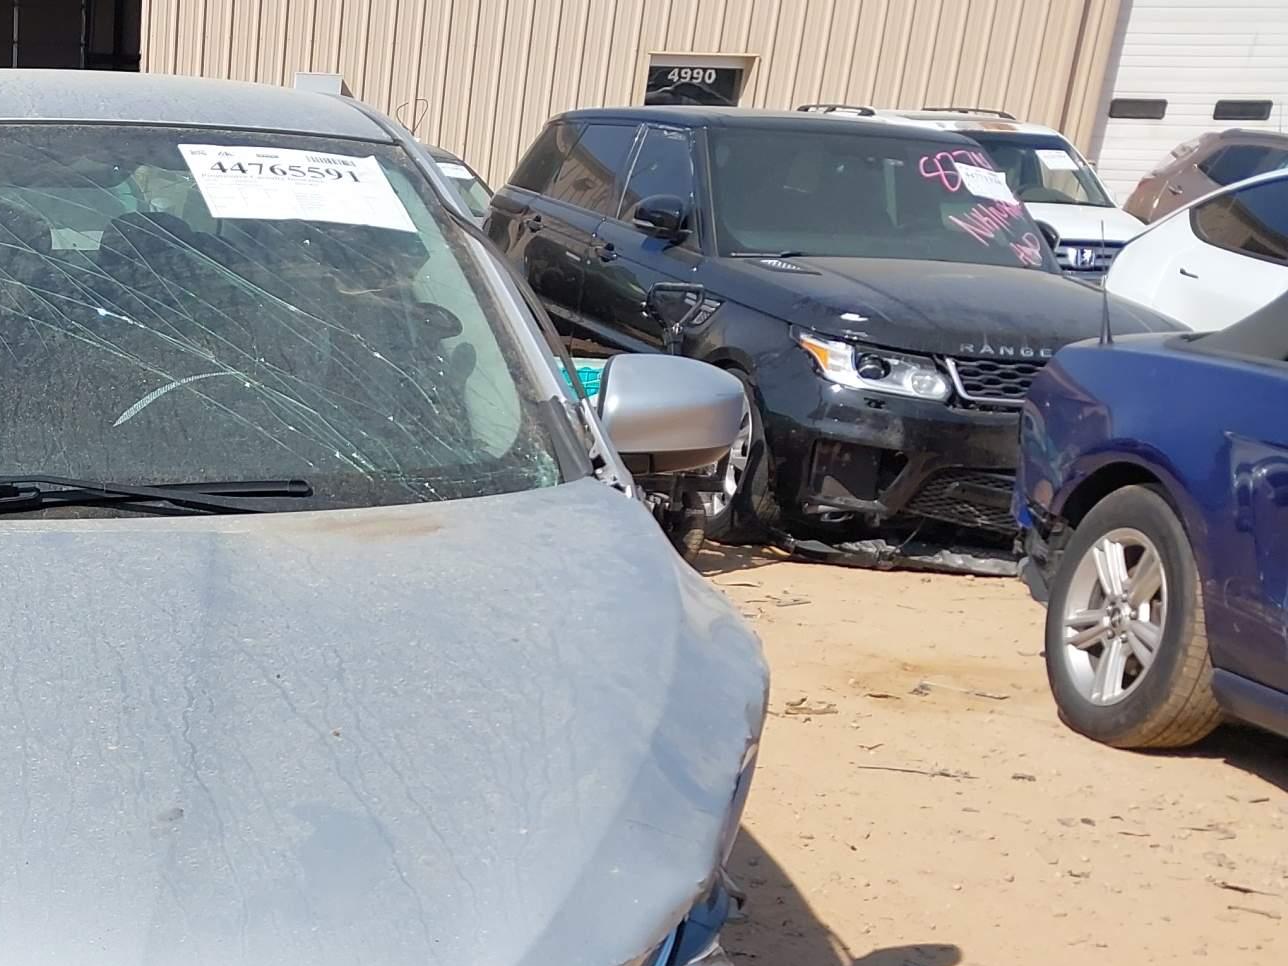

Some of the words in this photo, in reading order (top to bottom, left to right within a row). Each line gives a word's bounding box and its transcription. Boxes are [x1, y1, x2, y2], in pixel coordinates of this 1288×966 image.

[667, 67, 716, 84] 4990
[209, 160, 362, 183] 44765591
[959, 343, 1053, 358] RANGE
